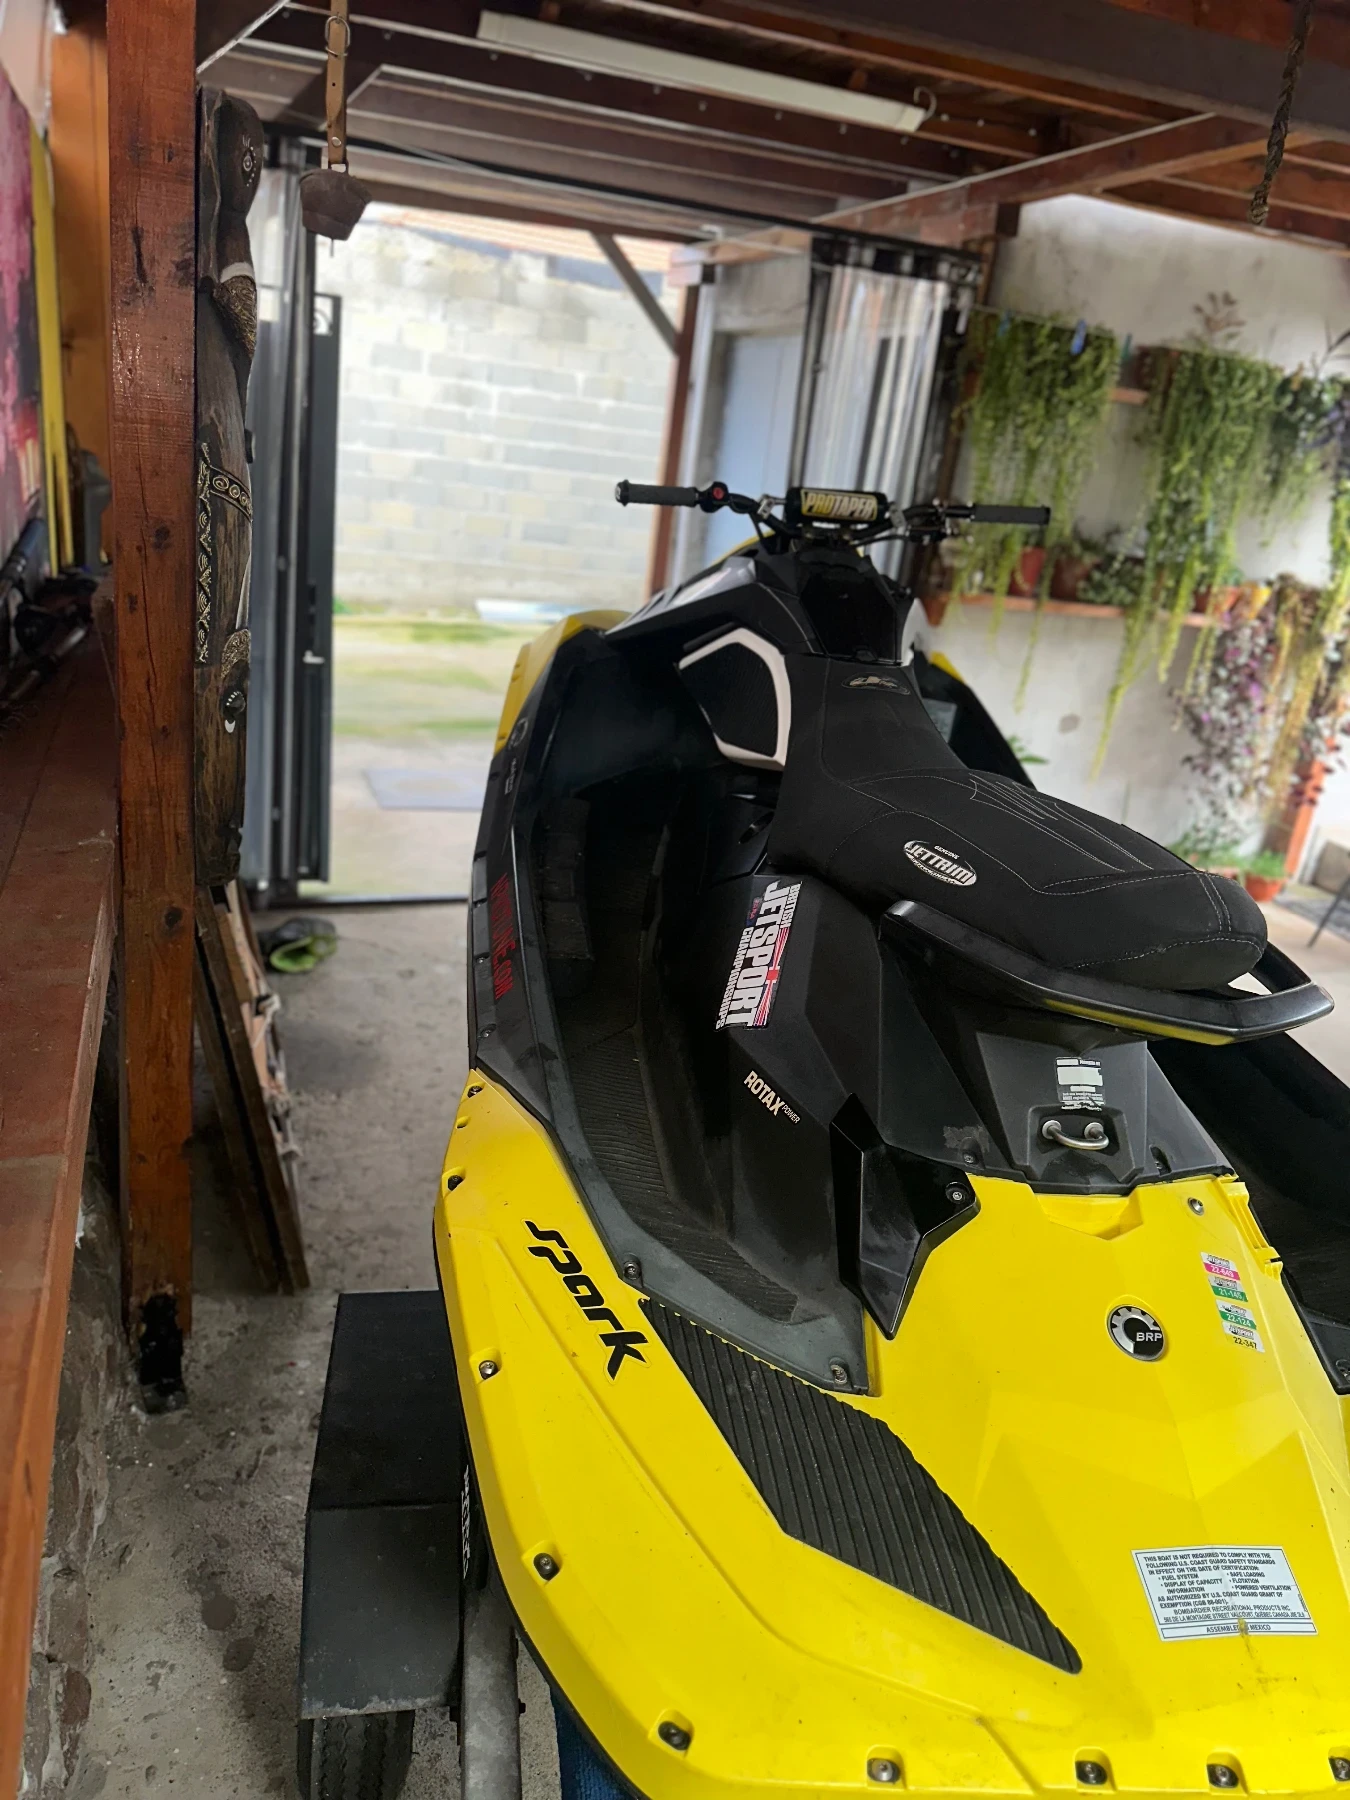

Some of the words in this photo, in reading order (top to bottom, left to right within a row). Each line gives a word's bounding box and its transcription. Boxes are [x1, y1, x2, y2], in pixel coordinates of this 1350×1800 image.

[805, 492, 875, 519] PROTAPER
[904, 845, 974, 884] JETTRIM
[780, 883, 802, 929] BRITISH
[725, 880, 790, 1026] JETSPORT
[716, 927, 754, 1030] CHAMPIONSHIPS
[743, 1070, 785, 1116] ROTAX
[782, 1104, 801, 1124] POWER
[1136, 1332, 1163, 1342] BRP
[1174, 1607, 1211, 1615] BOMBARDIER
[1212, 1605, 1253, 1613] RECREATIONAL
